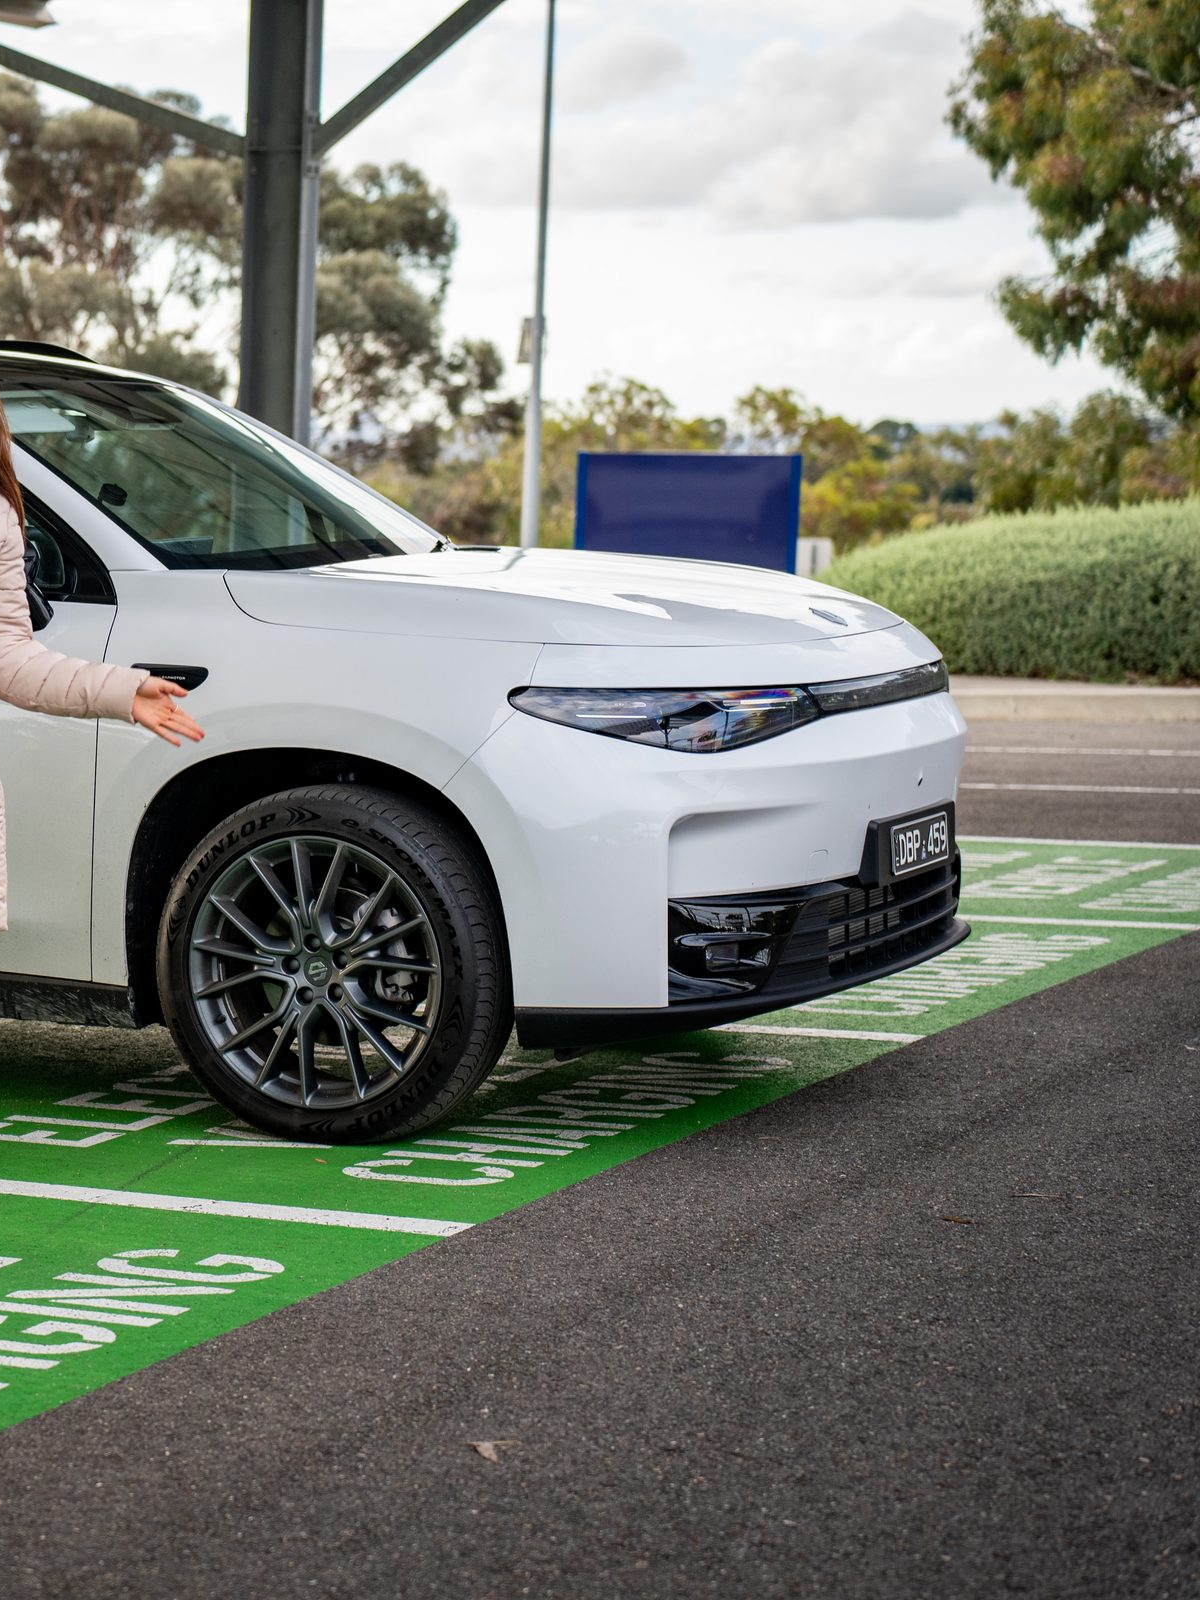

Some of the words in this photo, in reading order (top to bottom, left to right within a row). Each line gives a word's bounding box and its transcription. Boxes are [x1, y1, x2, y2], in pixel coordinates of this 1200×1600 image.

[185, 812, 277, 892] DUNLOP
[898, 829, 920, 866] DBP
[927, 820, 947, 856] 459
[790, 932, 1111, 1016] CHARGING
[342, 1051, 793, 1187] CHARGING
[346, 1056, 444, 1135] DUNLOP
